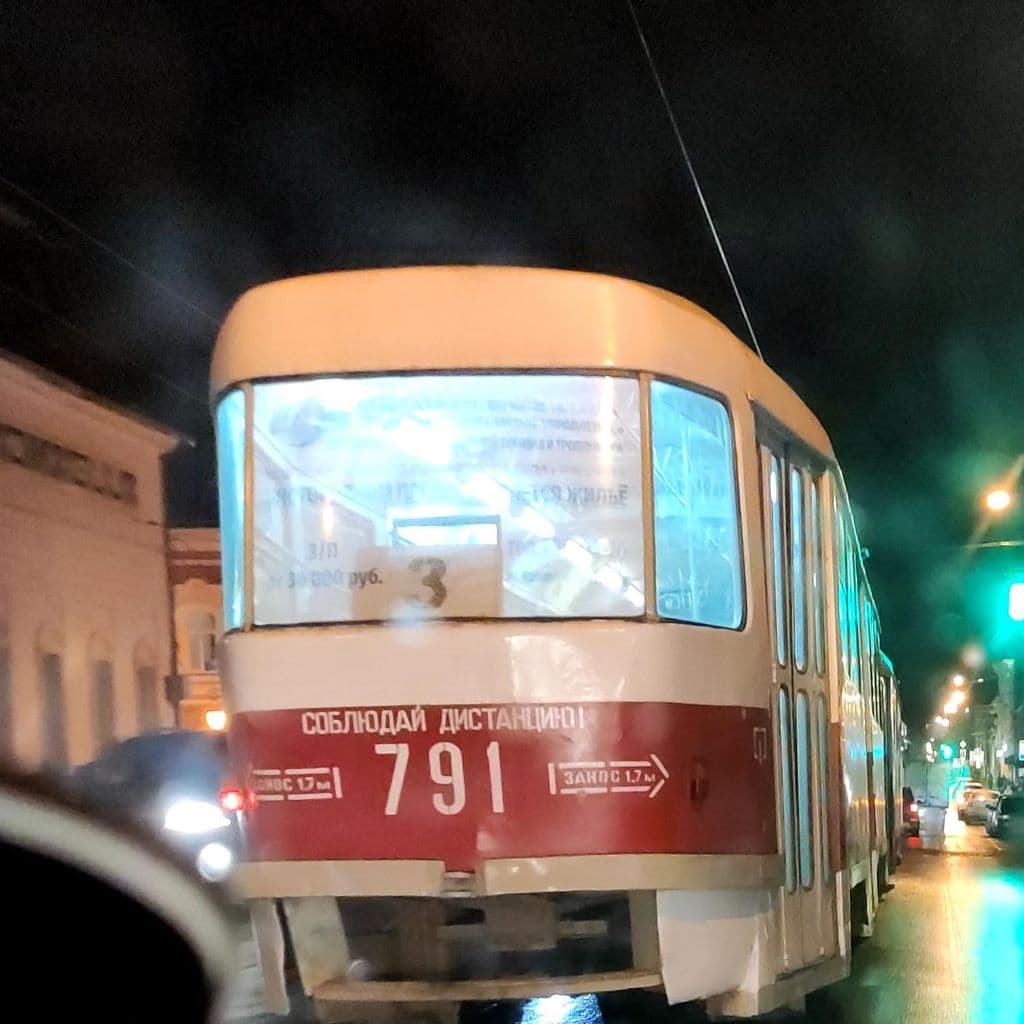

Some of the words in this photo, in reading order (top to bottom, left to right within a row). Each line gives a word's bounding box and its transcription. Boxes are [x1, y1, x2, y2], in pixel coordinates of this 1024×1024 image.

[349, 567, 383, 590] руб.
[408, 557, 448, 609] 3
[302, 705, 427, 736] СОБЛЮДАЙ
[439, 705, 585, 735] ДИСТАНЦИЮ!
[374, 741, 505, 815] 791
[564, 769, 620, 785] ЗАНОС
